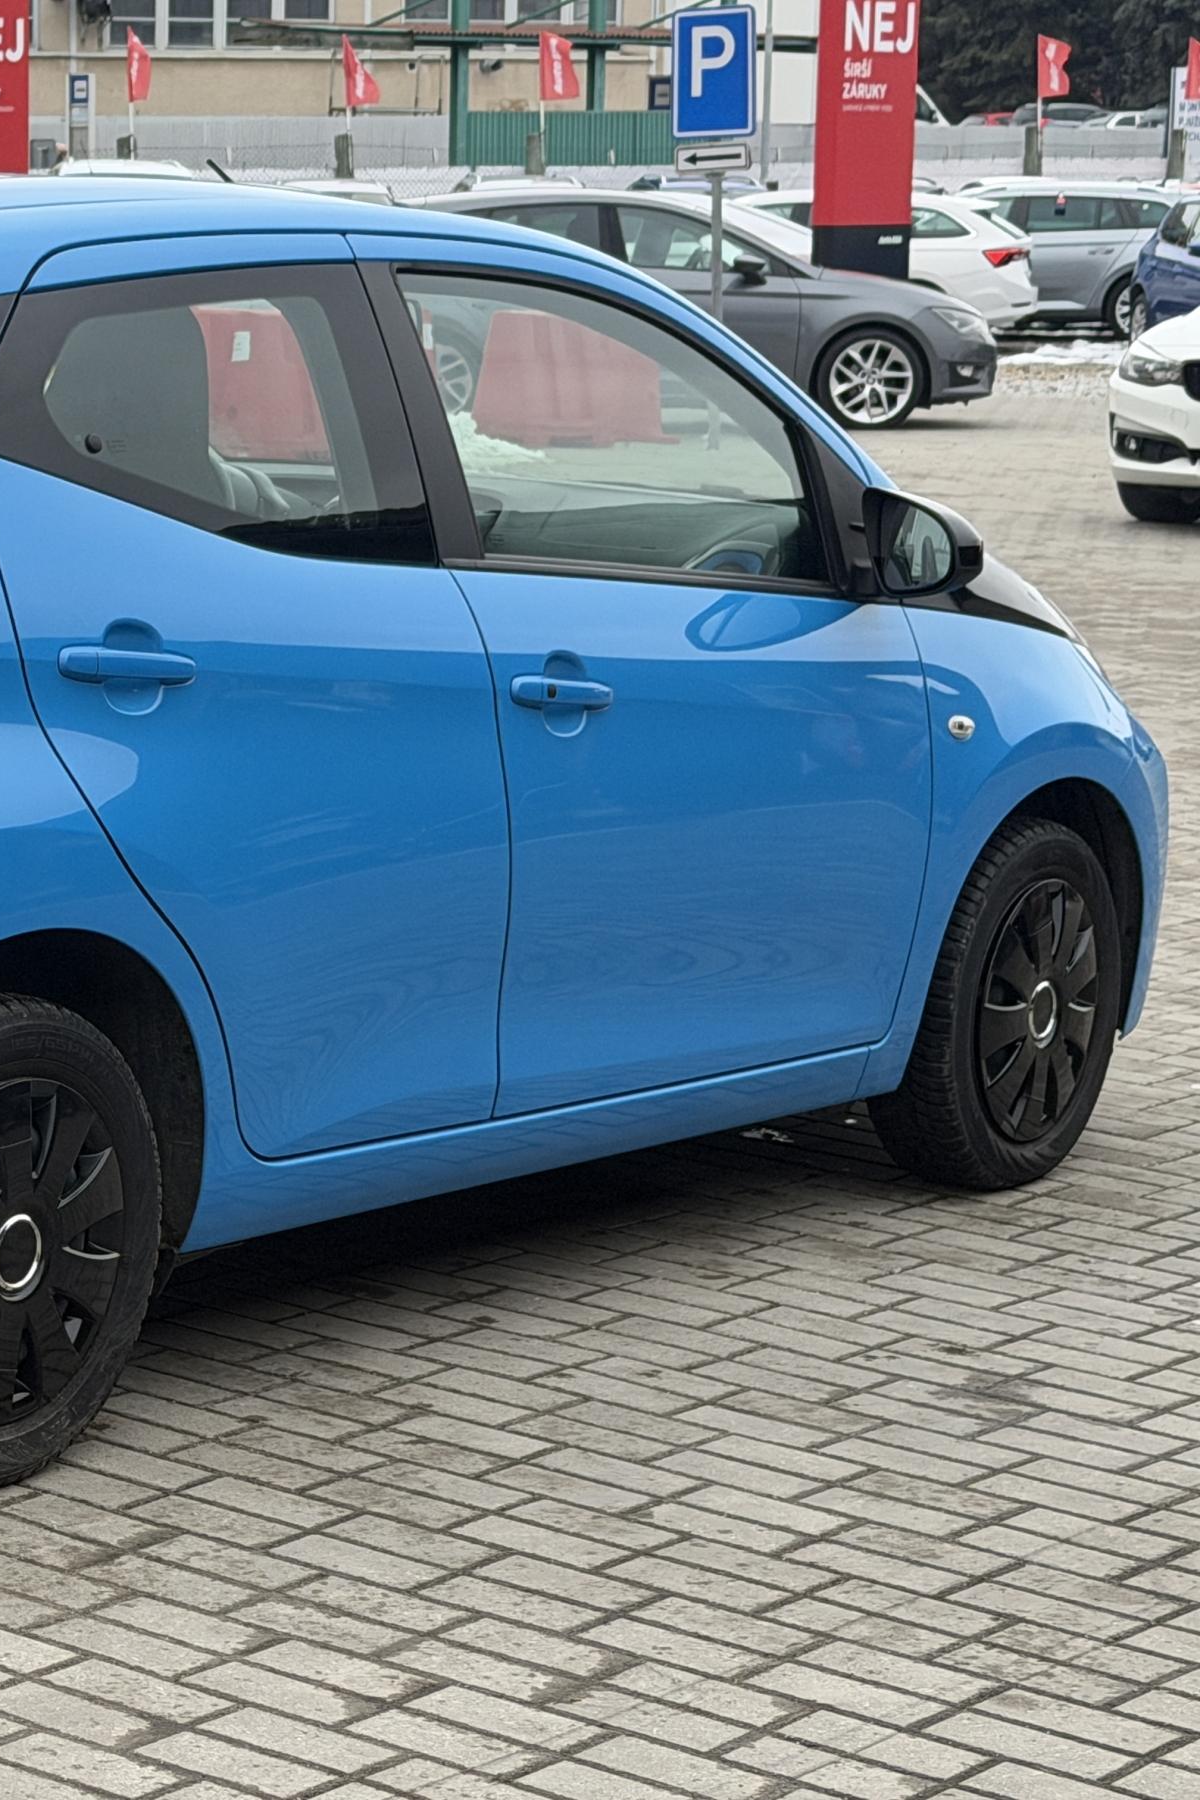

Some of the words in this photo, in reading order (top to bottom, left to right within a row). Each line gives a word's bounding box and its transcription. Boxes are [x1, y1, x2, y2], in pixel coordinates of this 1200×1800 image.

[844, 1, 915, 53] NEJ
[691, 25, 735, 97] P
[842, 79, 887, 99] ZÁRUKY
